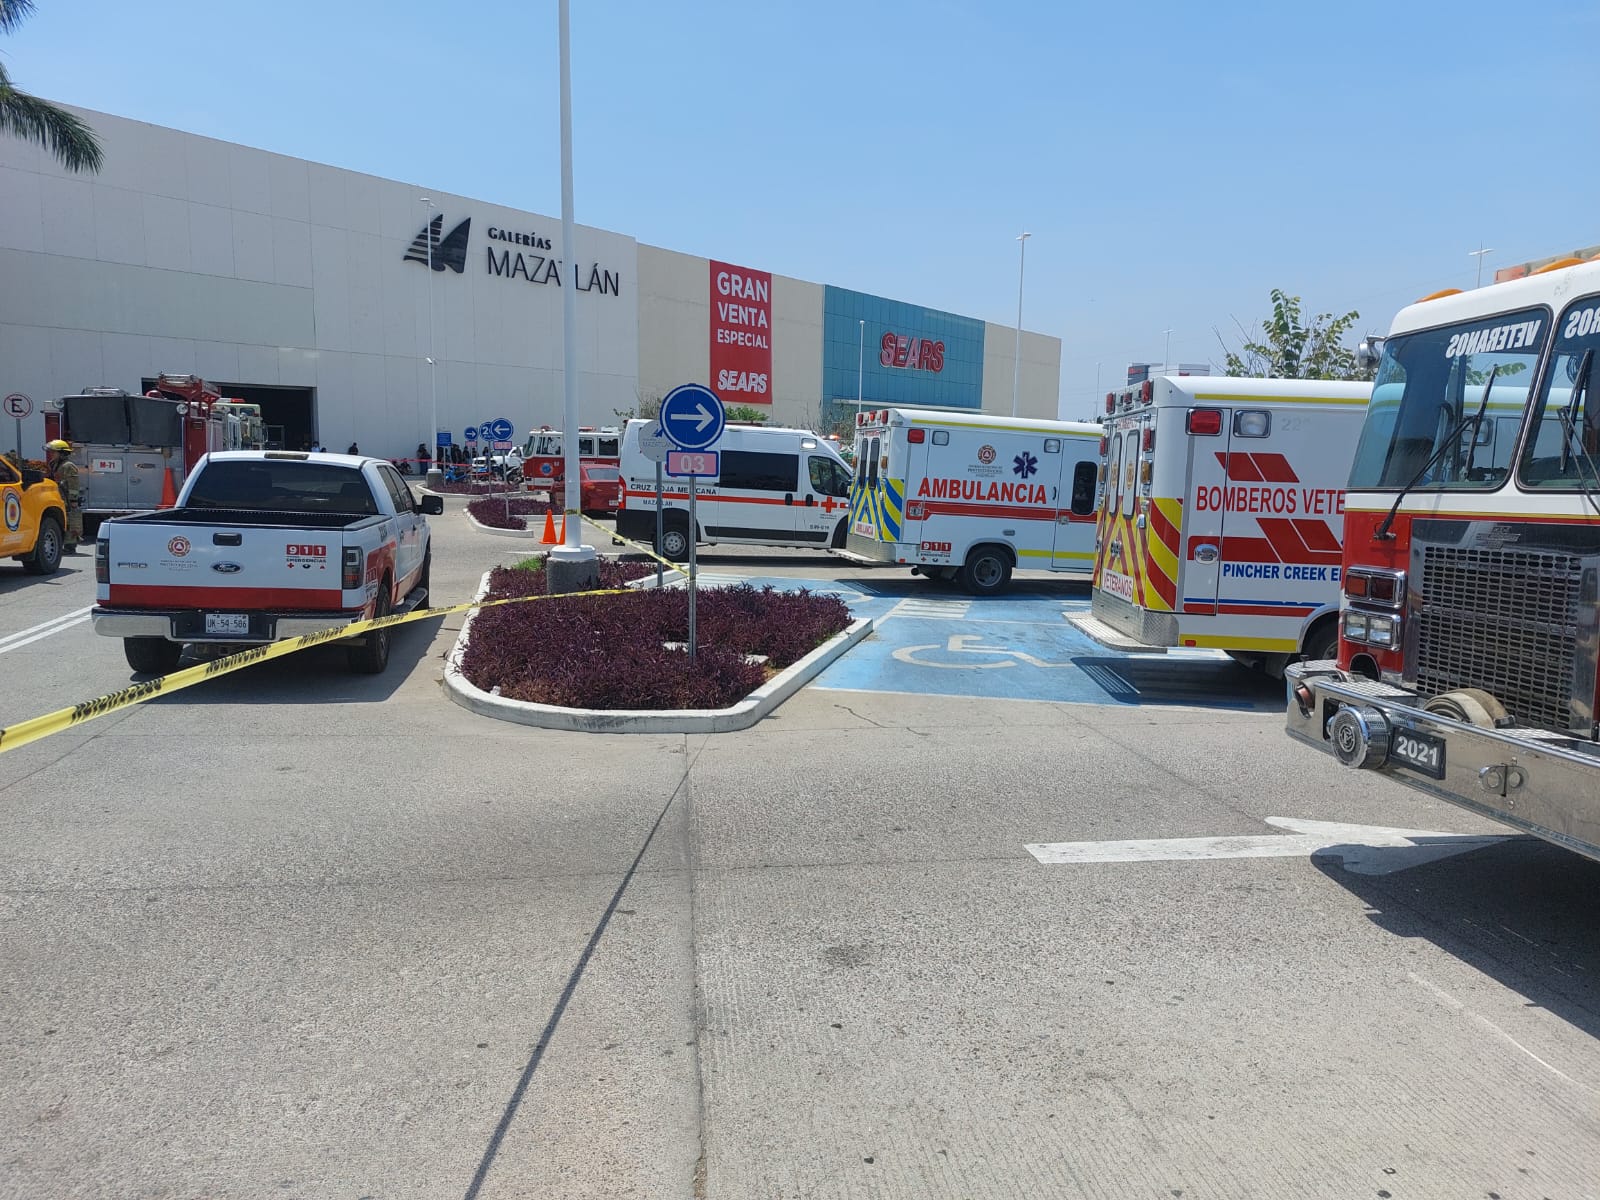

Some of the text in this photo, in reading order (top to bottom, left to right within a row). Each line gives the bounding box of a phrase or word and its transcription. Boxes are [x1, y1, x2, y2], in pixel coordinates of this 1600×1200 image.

[487, 227, 552, 251] GALERÍAS
[487, 246, 619, 297] MAZALÁN
[717, 272, 768, 303] GRAN
[717, 301, 768, 329] VENTA
[717, 328, 769, 349] ESPECIAL
[880, 331, 945, 374] SEARS
[717, 369, 768, 394] SEARS
[680, 455, 705, 472] 03
[630, 483, 651, 491] CRUZ
[677, 486, 717, 495] MECANA
[918, 477, 1047, 505] AMBULANCIA
[1196, 485, 1297, 514] BOMBEROS
[287, 544, 326, 556] 911
[921, 541, 952, 552] 911
[1223, 563, 1341, 581] PINCHER CREEK E
[1397, 735, 1438, 767] 2021
